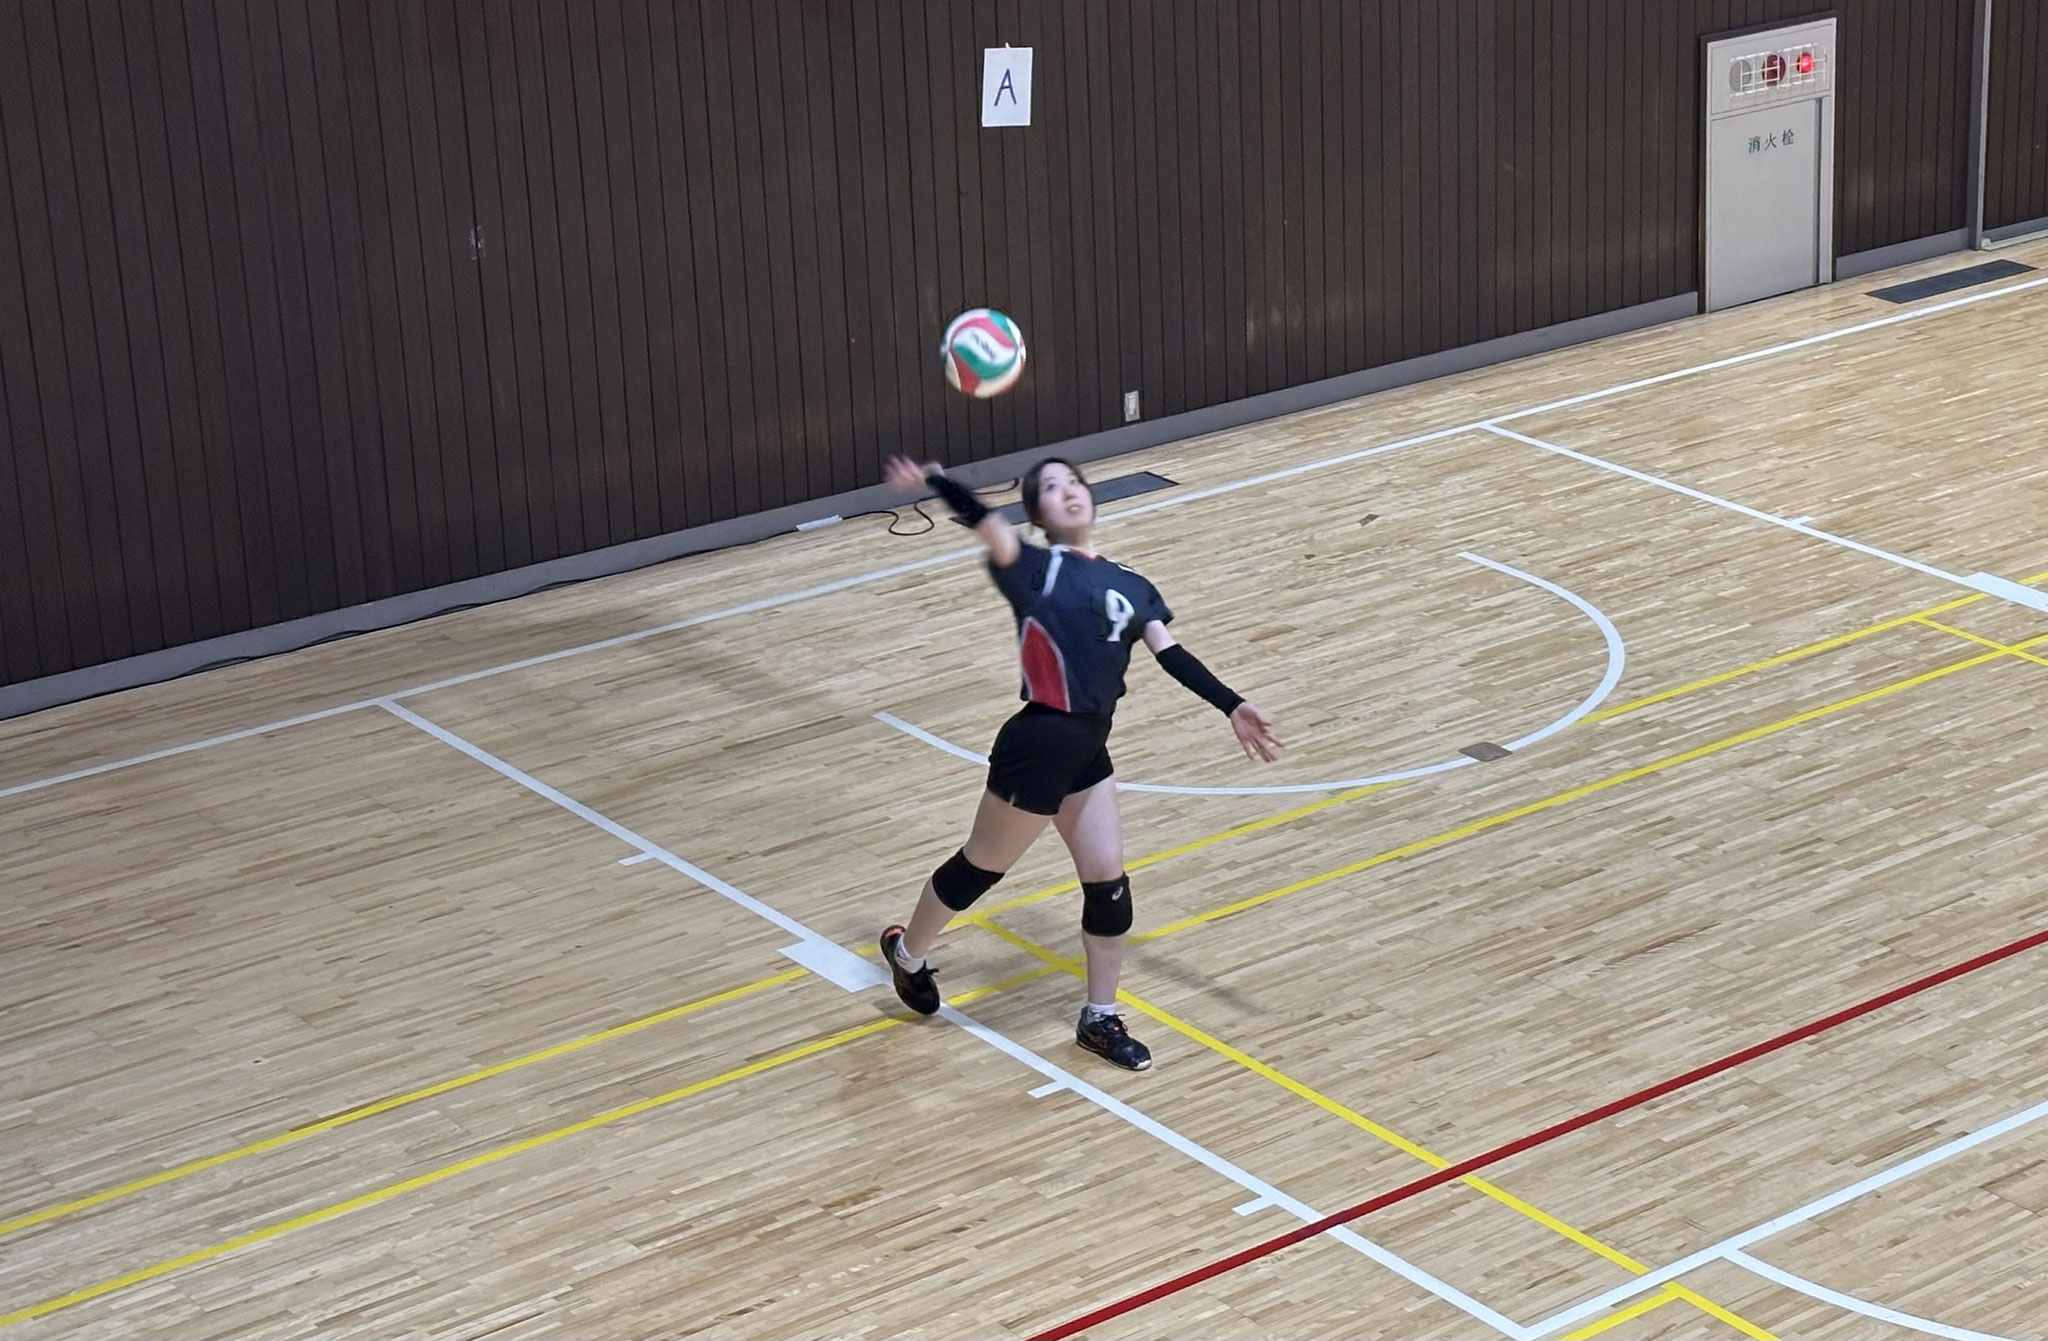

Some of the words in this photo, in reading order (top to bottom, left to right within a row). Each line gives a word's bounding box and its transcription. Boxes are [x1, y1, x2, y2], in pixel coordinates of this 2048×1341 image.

[993, 67, 1018, 107] A
[1747, 128, 1795, 154] 消火栓
[1105, 588, 1135, 642] 9
